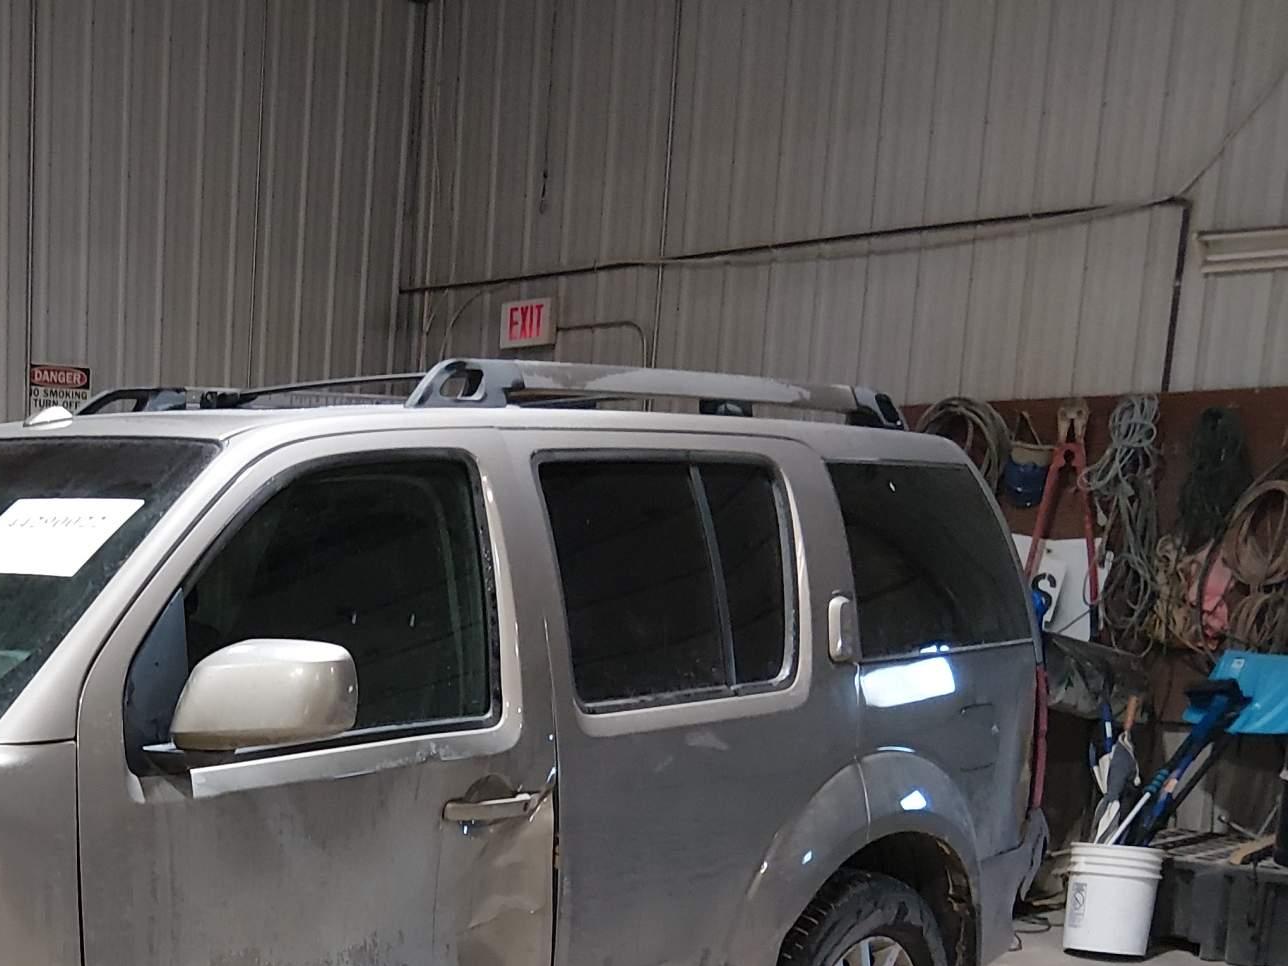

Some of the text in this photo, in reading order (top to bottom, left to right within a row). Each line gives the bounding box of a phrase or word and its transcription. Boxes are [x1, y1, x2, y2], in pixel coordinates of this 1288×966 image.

[509, 303, 544, 342] EXIT
[34, 370, 82, 385] DANGER
[43, 390, 88, 400] SMOKING
